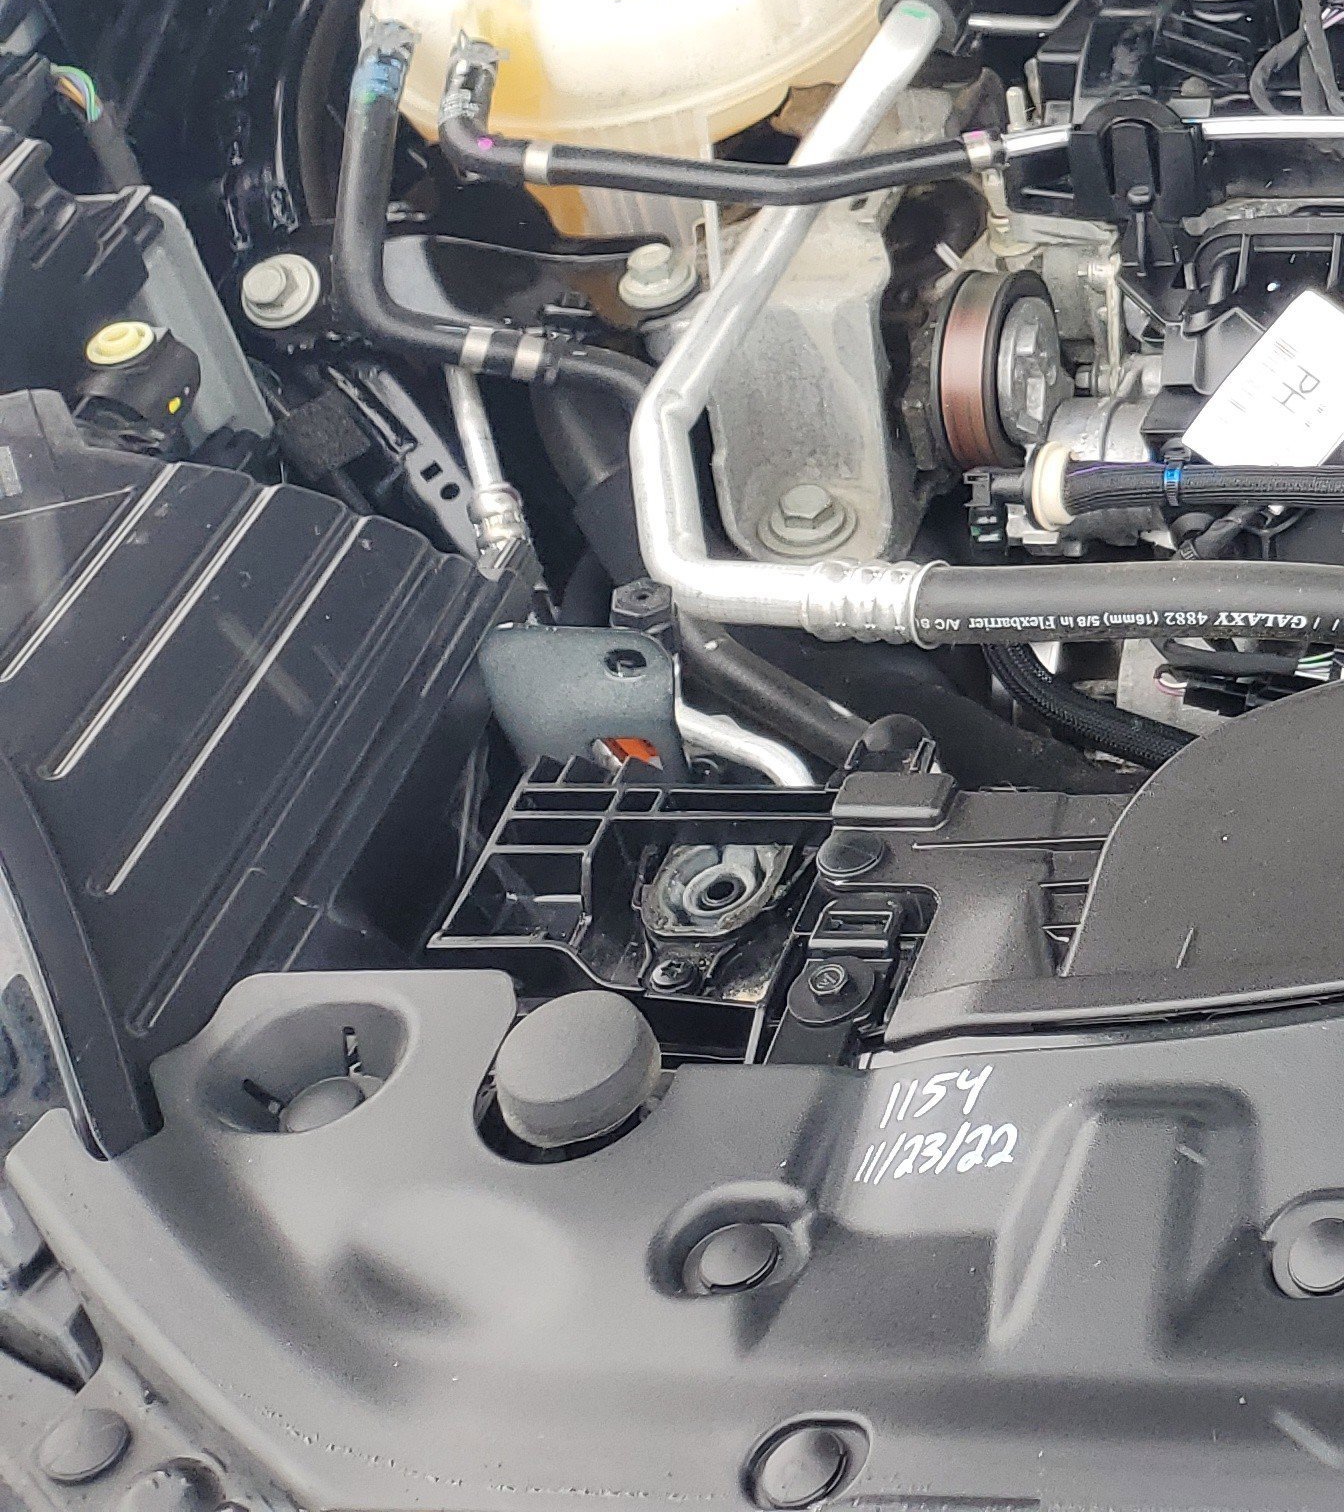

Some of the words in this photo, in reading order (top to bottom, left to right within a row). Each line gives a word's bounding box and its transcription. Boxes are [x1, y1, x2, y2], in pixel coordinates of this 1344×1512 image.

[934, 618, 961, 631] A/C
[967, 615, 1056, 631] Flexbarrier
[1076, 614, 1100, 626] 5/8
[1103, 610, 1159, 626] (16mm)
[1164, 611, 1208, 626] 4882
[1212, 611, 1307, 629] GALAXY
[879, 1064, 994, 1129] 1154
[853, 1122, 1018, 1185] 11/23/22
